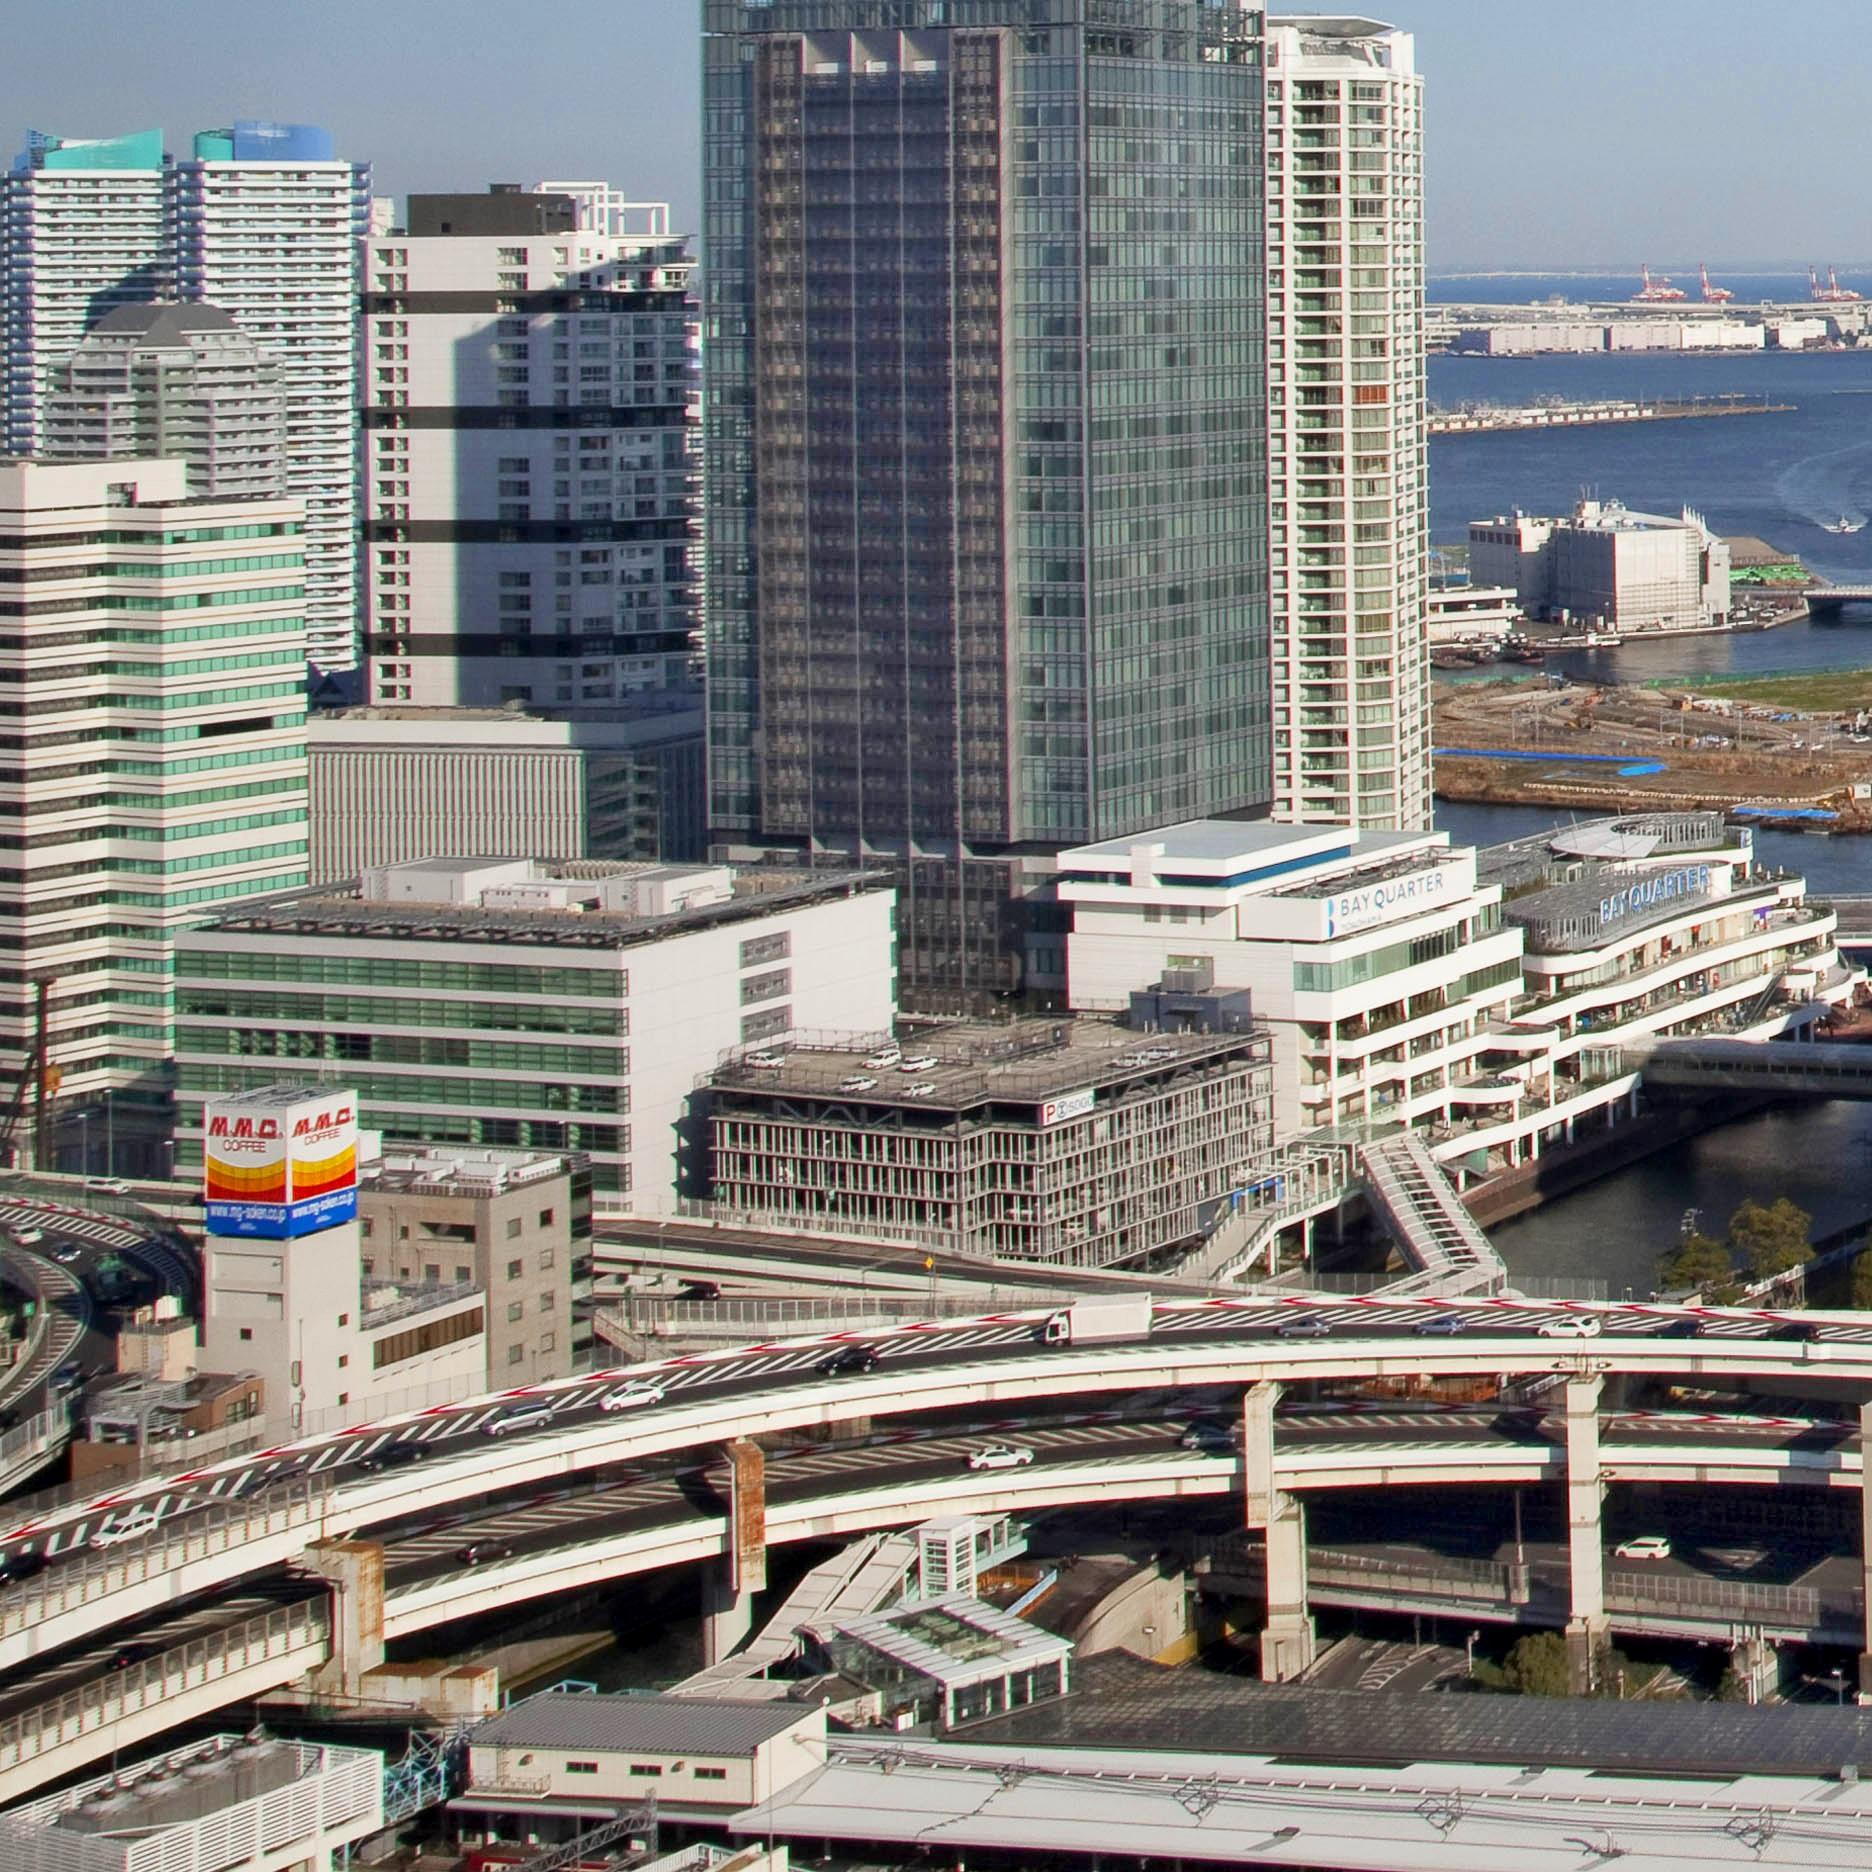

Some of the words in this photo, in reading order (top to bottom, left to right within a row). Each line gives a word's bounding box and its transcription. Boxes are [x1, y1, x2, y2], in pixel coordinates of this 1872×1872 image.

[1341, 893, 1370, 916] BAY
[1374, 873, 1444, 909] QUARTER
[1600, 889, 1628, 924] BAY
[1629, 864, 1709, 912] QUARTER
[1047, 1104, 1056, 1124] P
[224, 1139, 266, 1153] COFFEE
[304, 1128, 341, 1146] COFFEE
